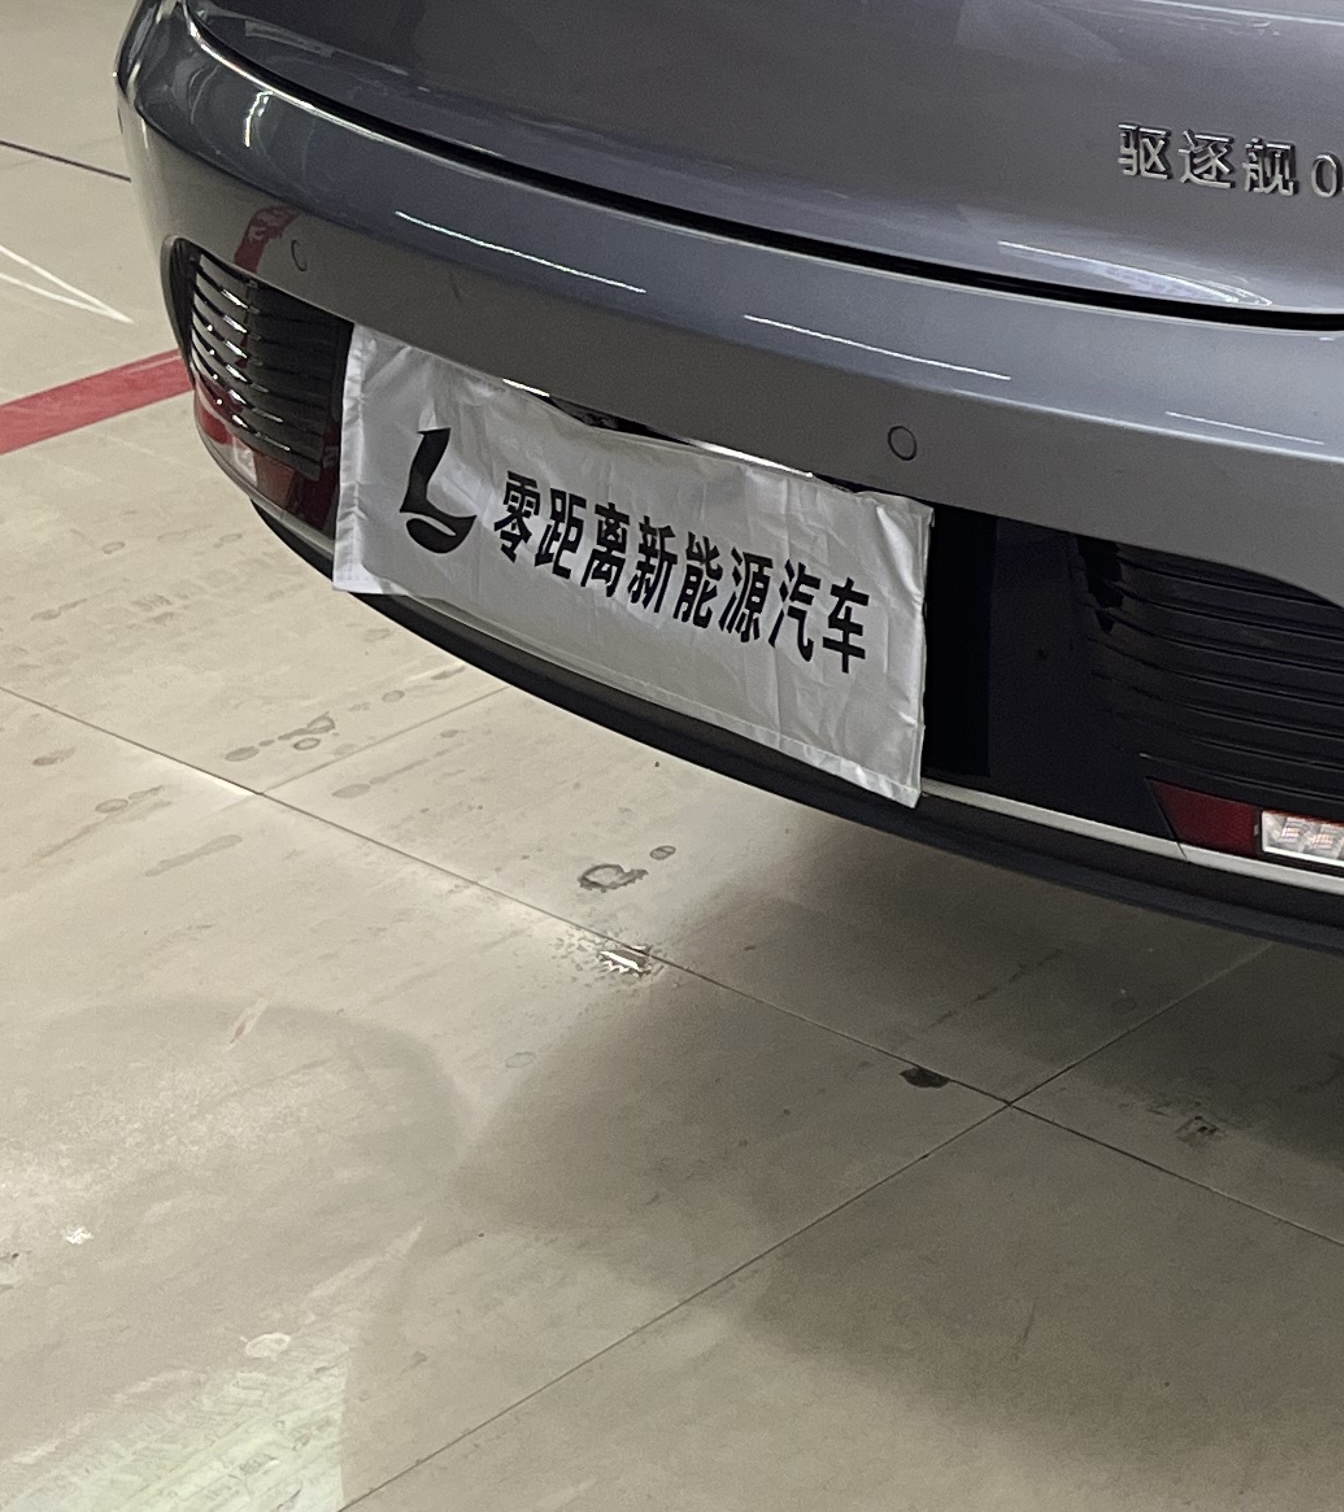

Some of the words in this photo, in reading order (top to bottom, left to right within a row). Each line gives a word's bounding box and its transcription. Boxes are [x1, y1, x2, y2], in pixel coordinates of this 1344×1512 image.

[1117, 122, 1300, 197] 驱逐舰
[492, 469, 870, 675] 零距离新能源汽车
